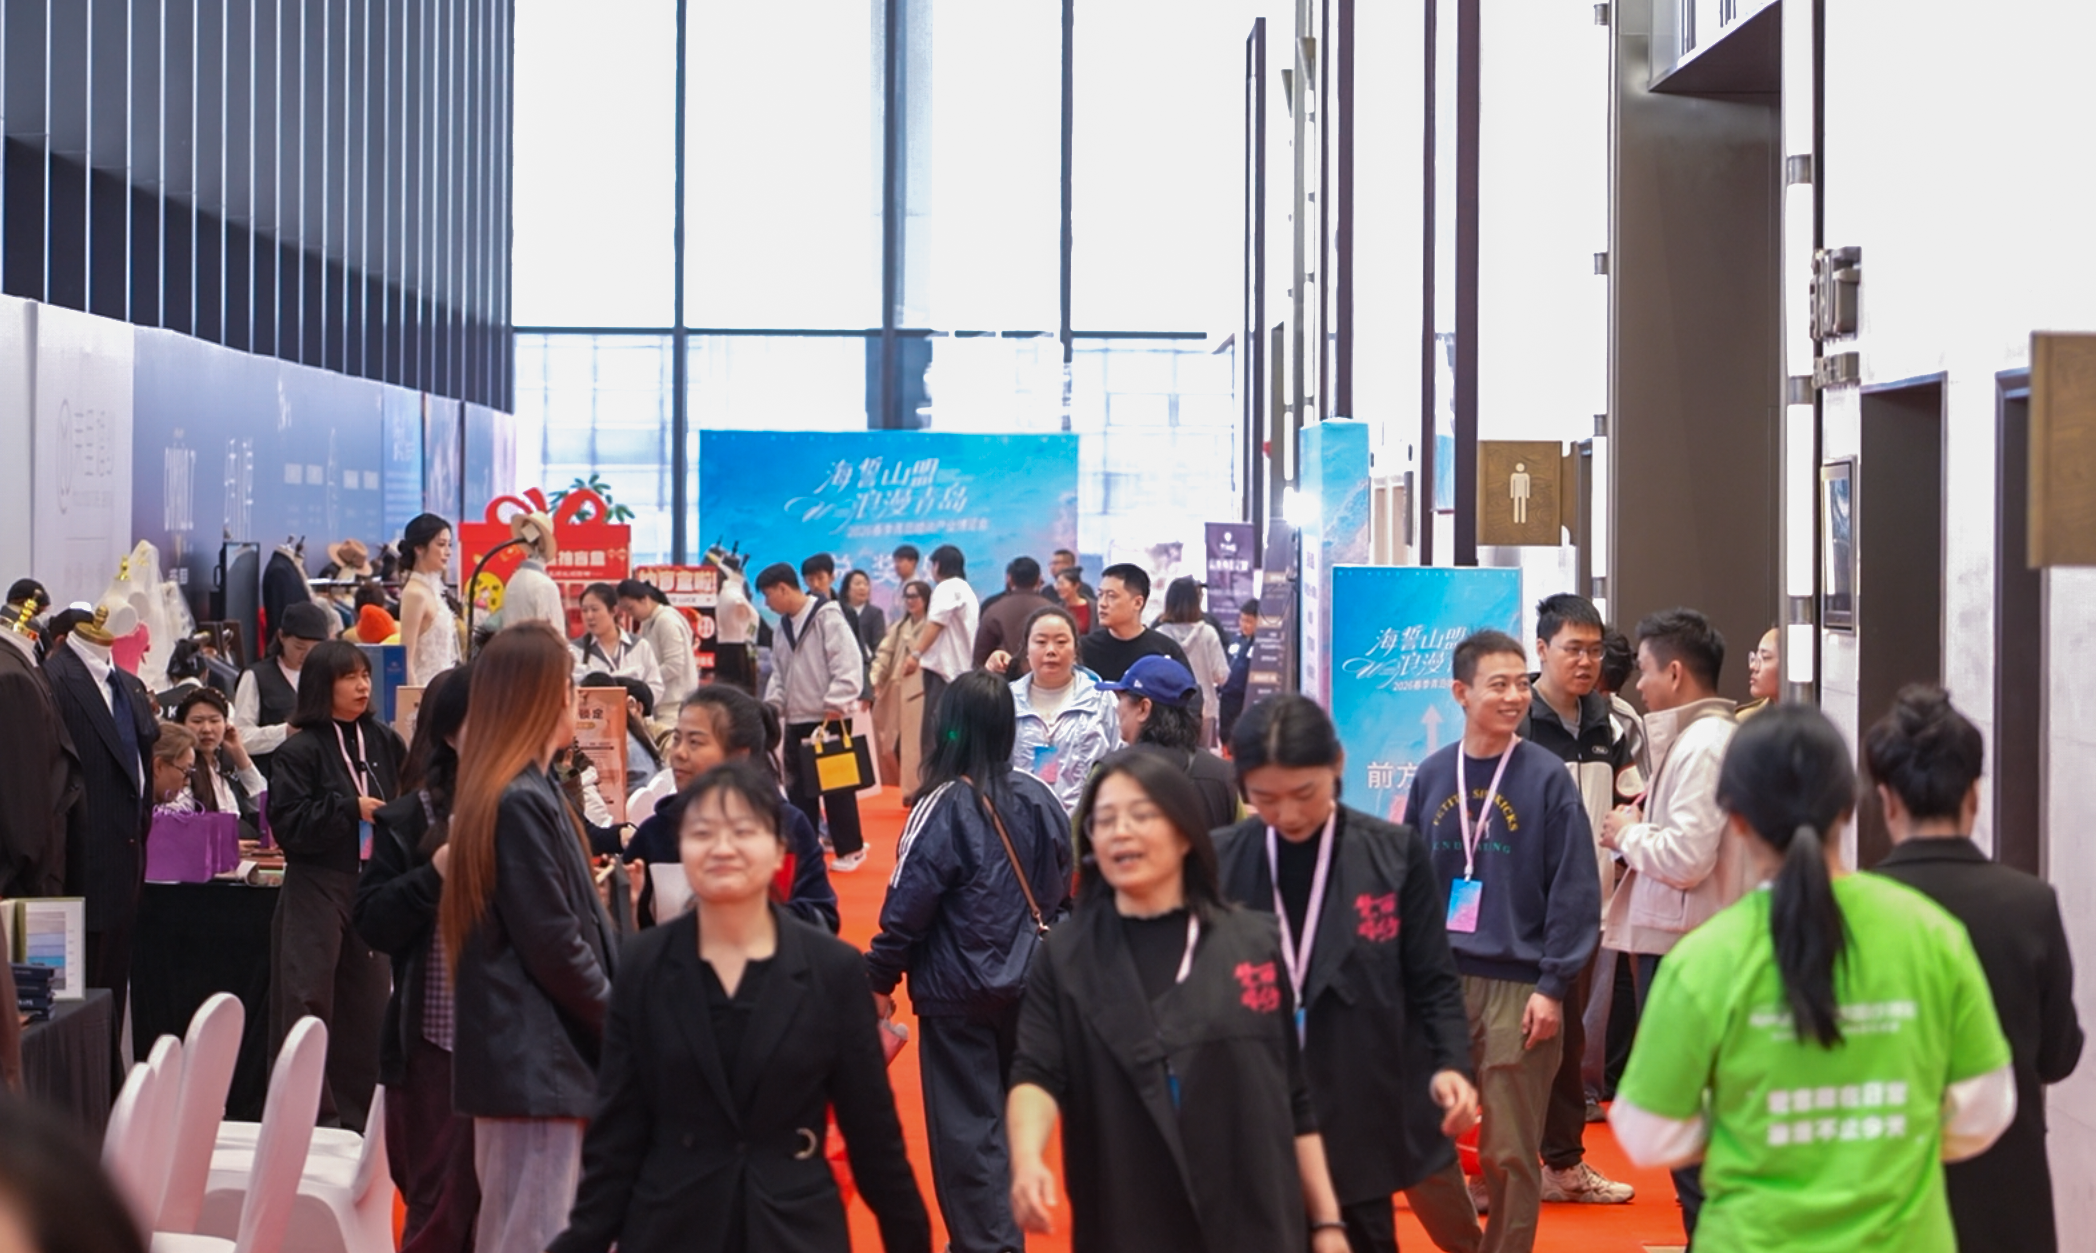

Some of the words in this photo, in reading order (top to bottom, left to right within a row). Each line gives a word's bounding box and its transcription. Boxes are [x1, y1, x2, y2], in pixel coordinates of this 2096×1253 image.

[813, 456, 940, 494] 海誓山盟
[856, 484, 968, 518] 浪漫青岛
[832, 553, 932, 582] 兑奖
[1365, 624, 1467, 656] 海誓山盟
[1399, 651, 1453, 676] 浪漫
